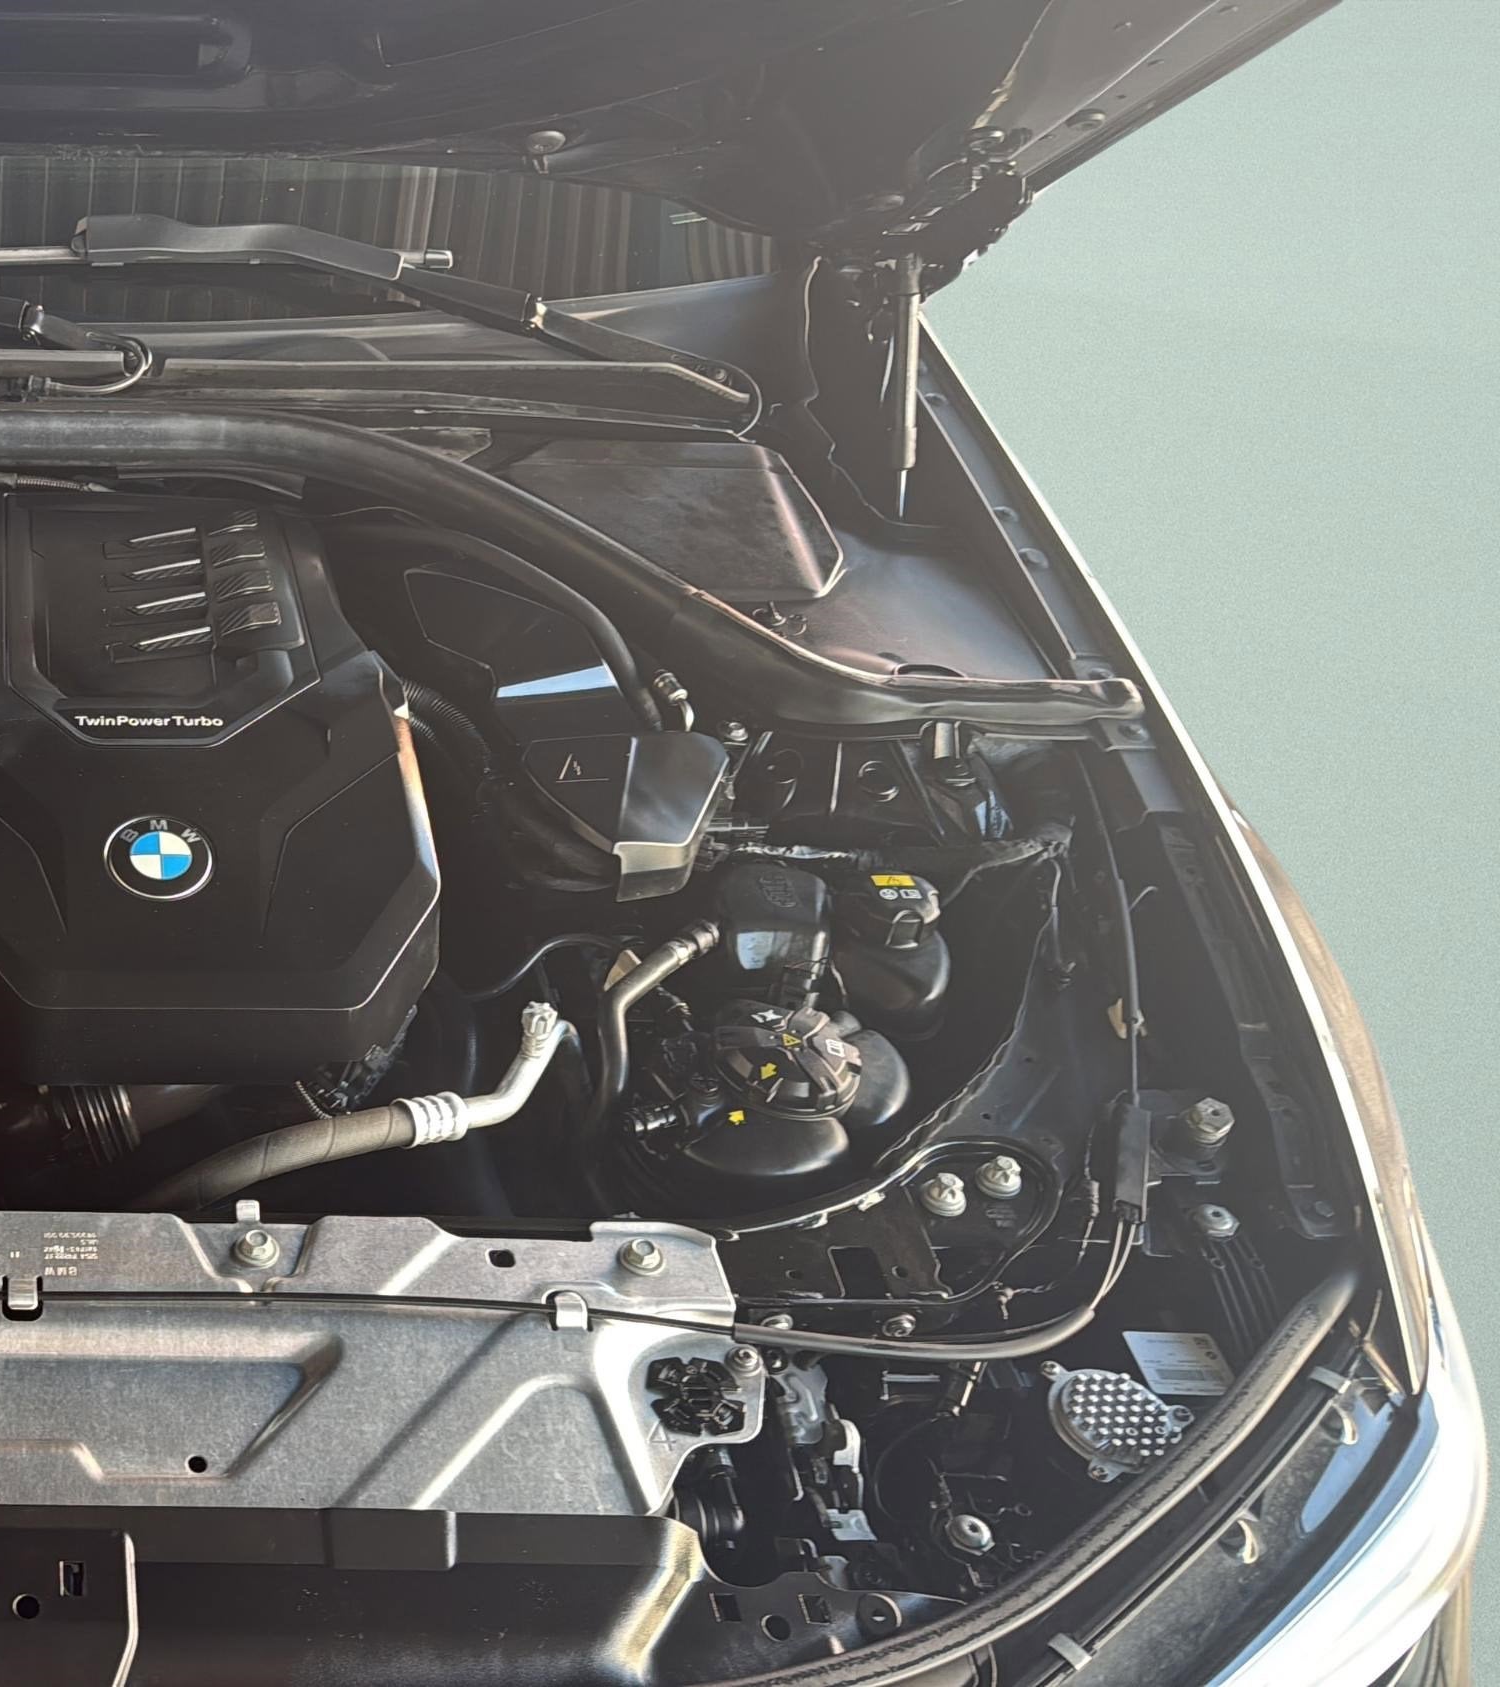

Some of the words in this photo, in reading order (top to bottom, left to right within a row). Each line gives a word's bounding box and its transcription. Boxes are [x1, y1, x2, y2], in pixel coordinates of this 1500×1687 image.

[74, 715, 170, 727] TwinPower
[171, 715, 224, 727] Turbo
[120, 819, 200, 843] BMW
